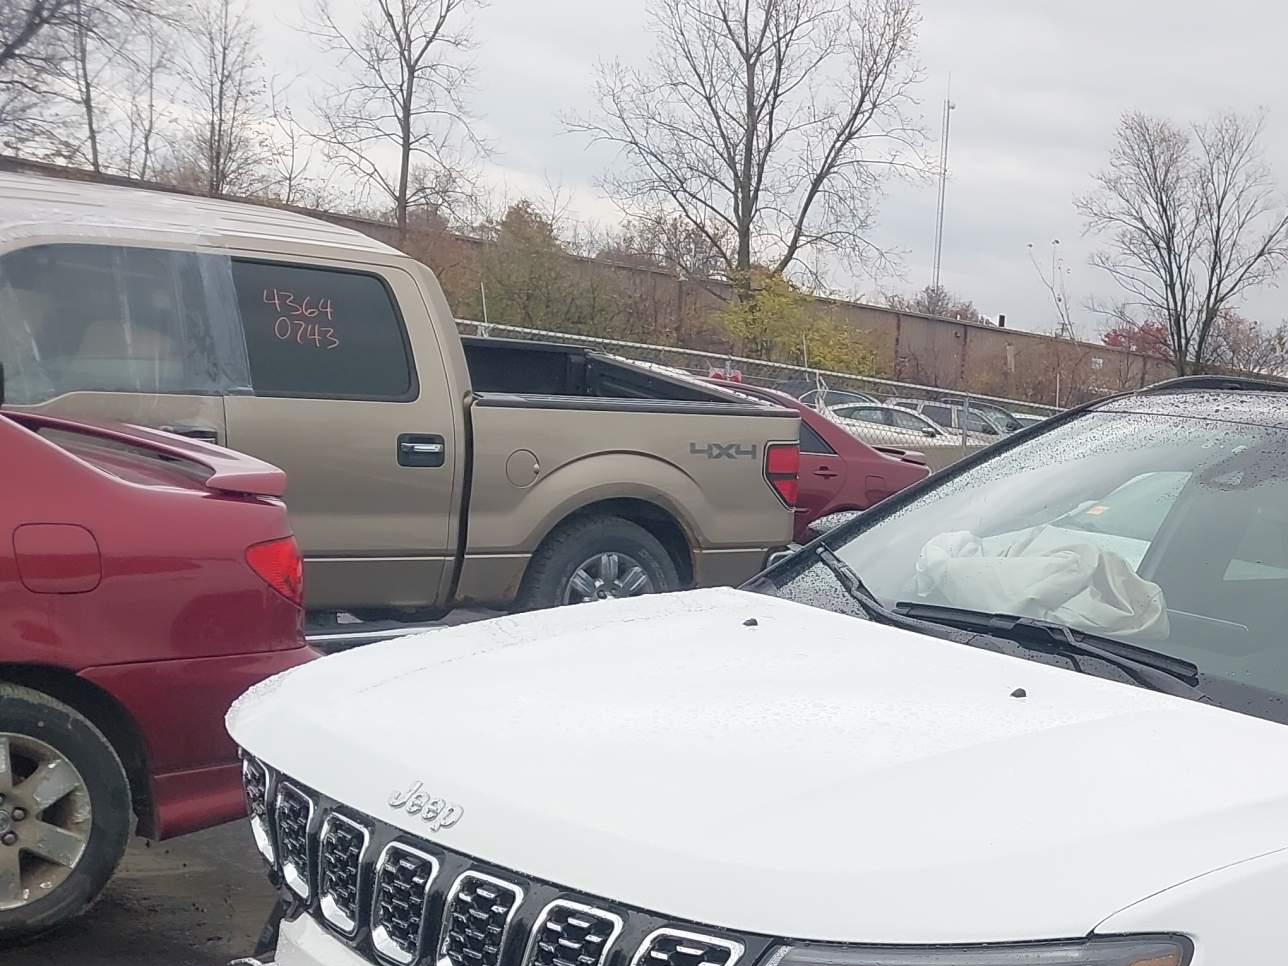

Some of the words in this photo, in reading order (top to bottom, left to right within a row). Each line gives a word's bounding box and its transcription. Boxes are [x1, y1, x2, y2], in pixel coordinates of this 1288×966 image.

[263, 288, 334, 320] 4364
[275, 317, 340, 349] 0743
[388, 780, 464, 832] Jeep
